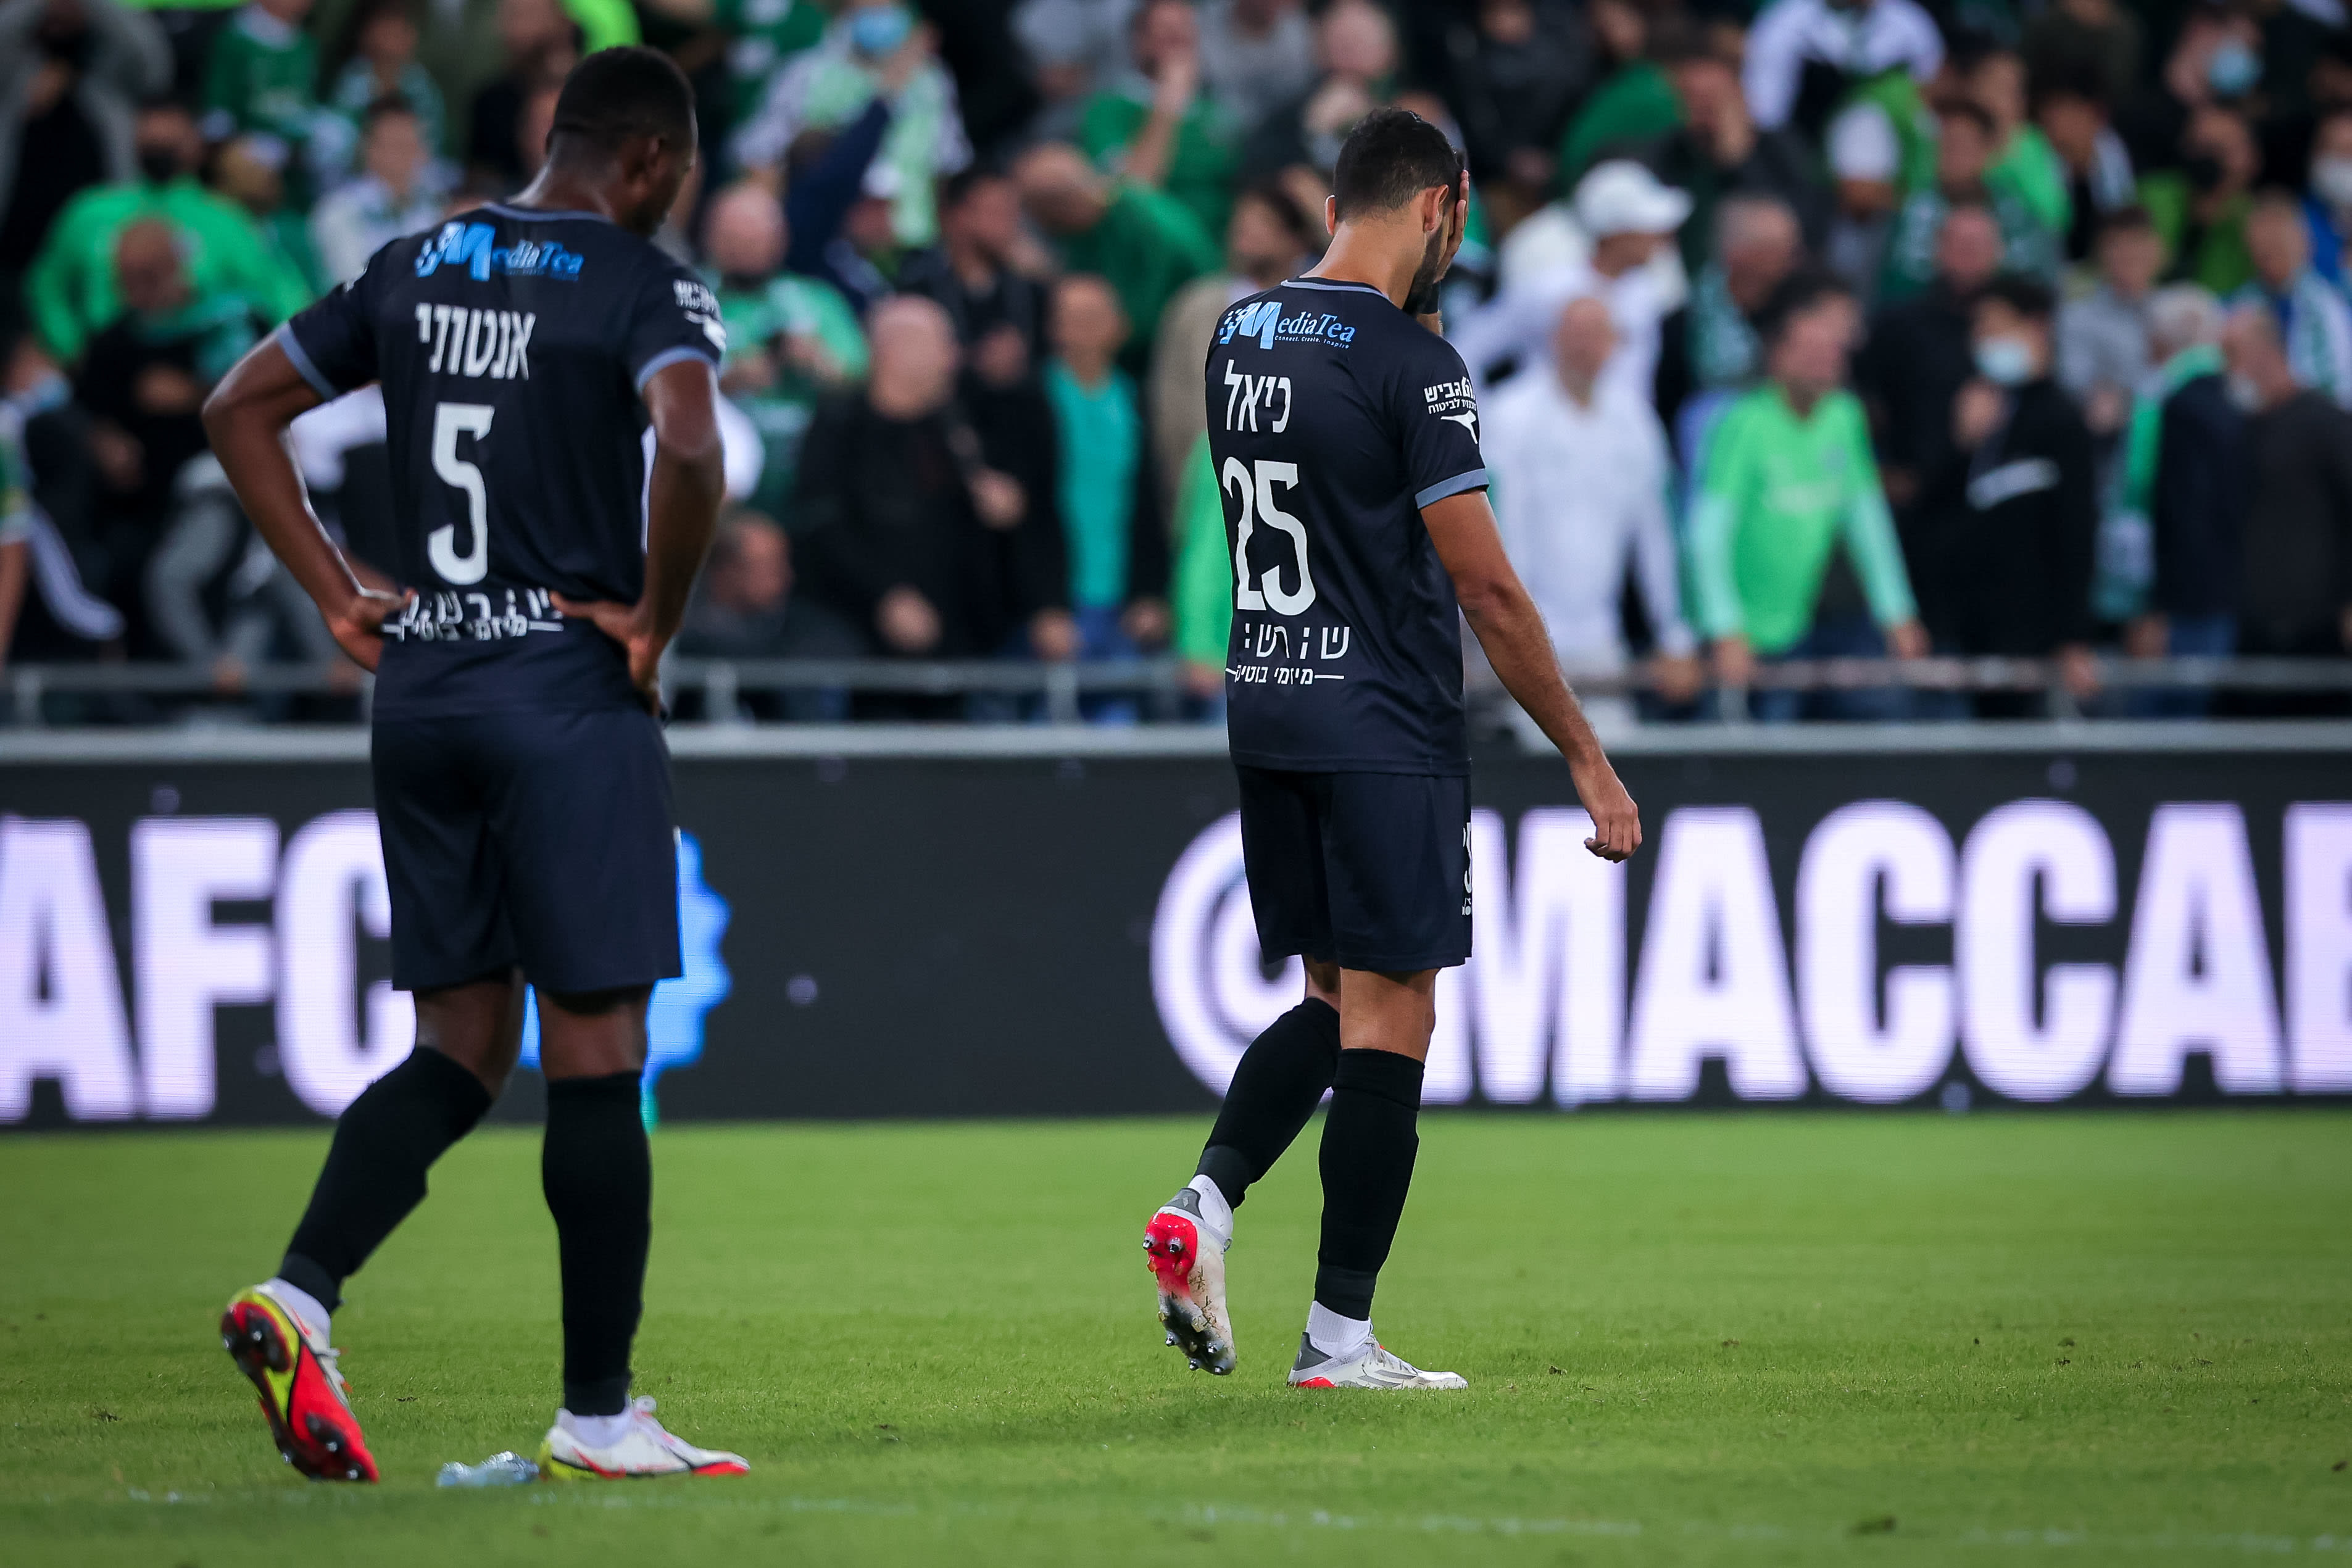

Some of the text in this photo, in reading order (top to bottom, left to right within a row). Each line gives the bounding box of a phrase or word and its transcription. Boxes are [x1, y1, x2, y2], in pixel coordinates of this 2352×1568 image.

[415, 302, 536, 381] אנטוני
[1219, 301, 1356, 350] MediaTea
[1224, 359, 1292, 433] כיאל
[1427, 397, 1461, 415] לביטוח
[427, 402, 495, 586] 5
[1222, 456, 1317, 616] 25
